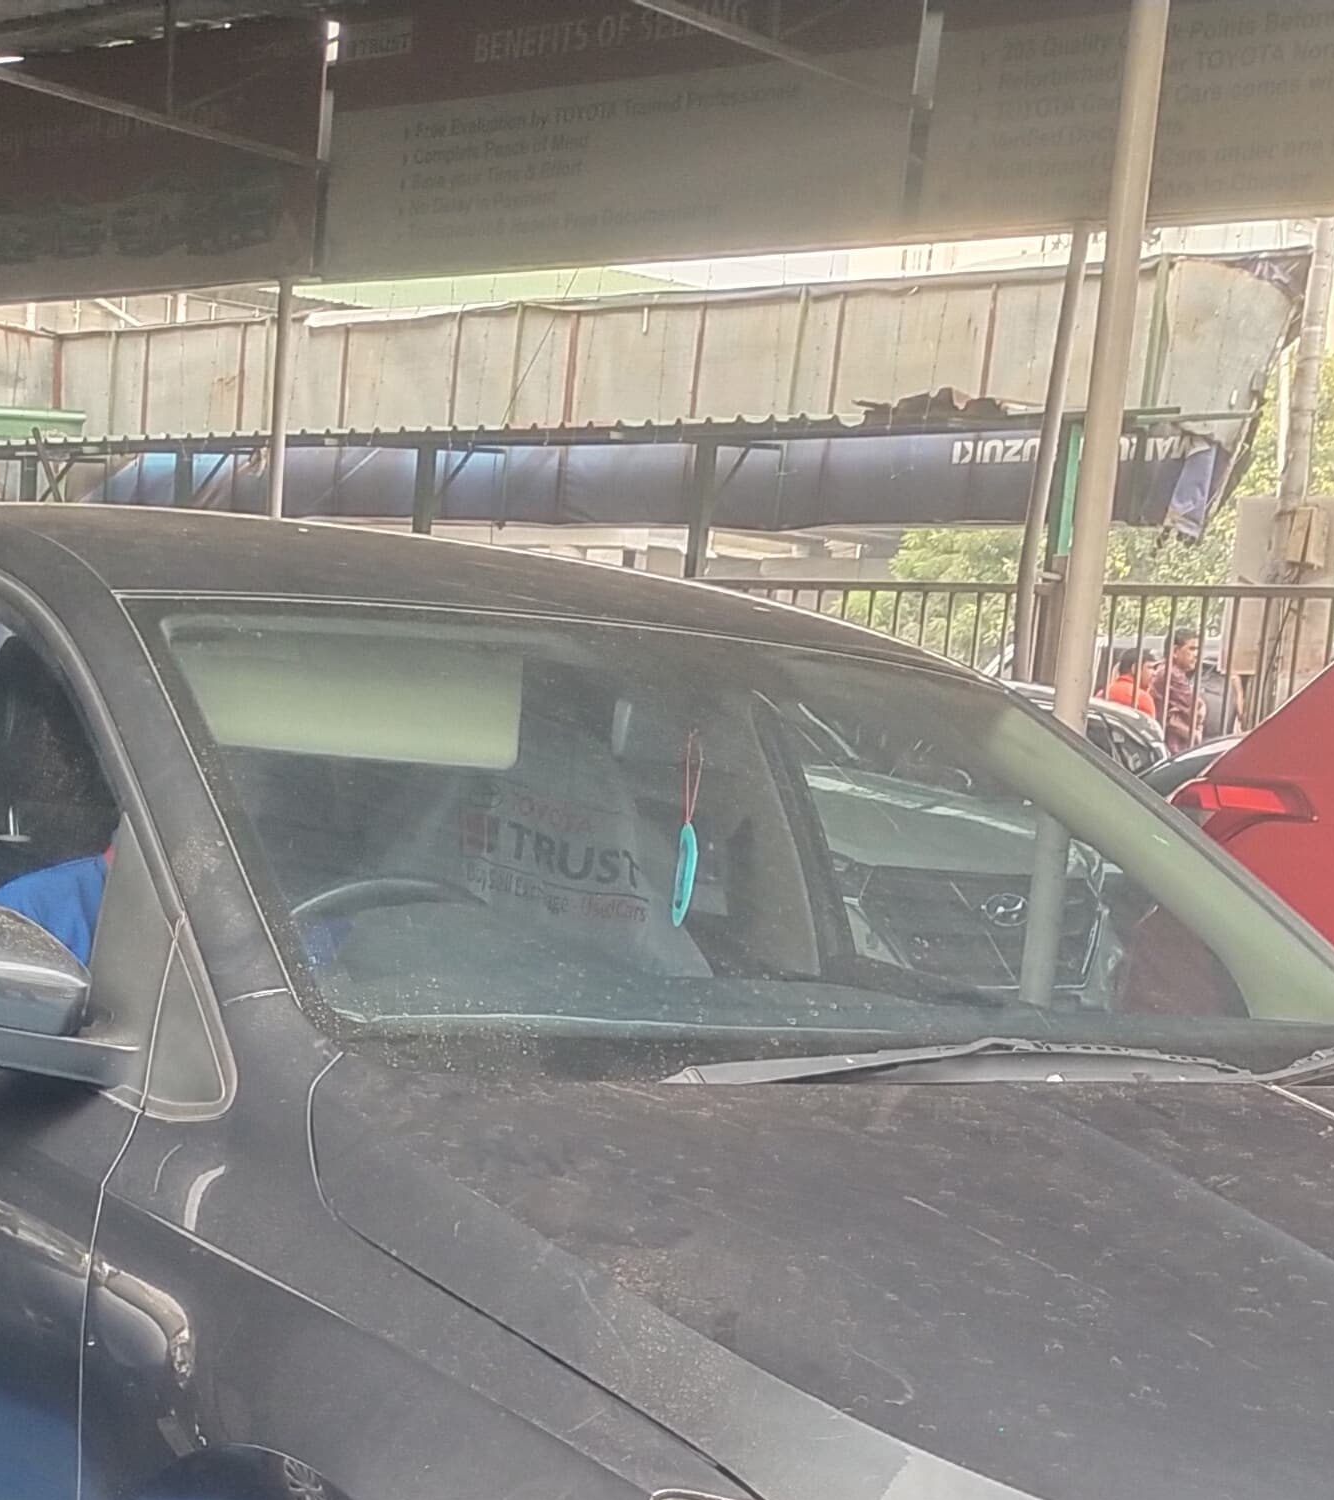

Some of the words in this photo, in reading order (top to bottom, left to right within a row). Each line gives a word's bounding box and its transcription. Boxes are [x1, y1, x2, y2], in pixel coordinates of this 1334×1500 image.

[474, 21, 588, 64] BENEFITS
[598, 13, 632, 47] OF
[1196, 43, 1284, 71] TOYOTA
[554, 101, 617, 126] TOYOTA
[507, 819, 640, 890] TRUST
